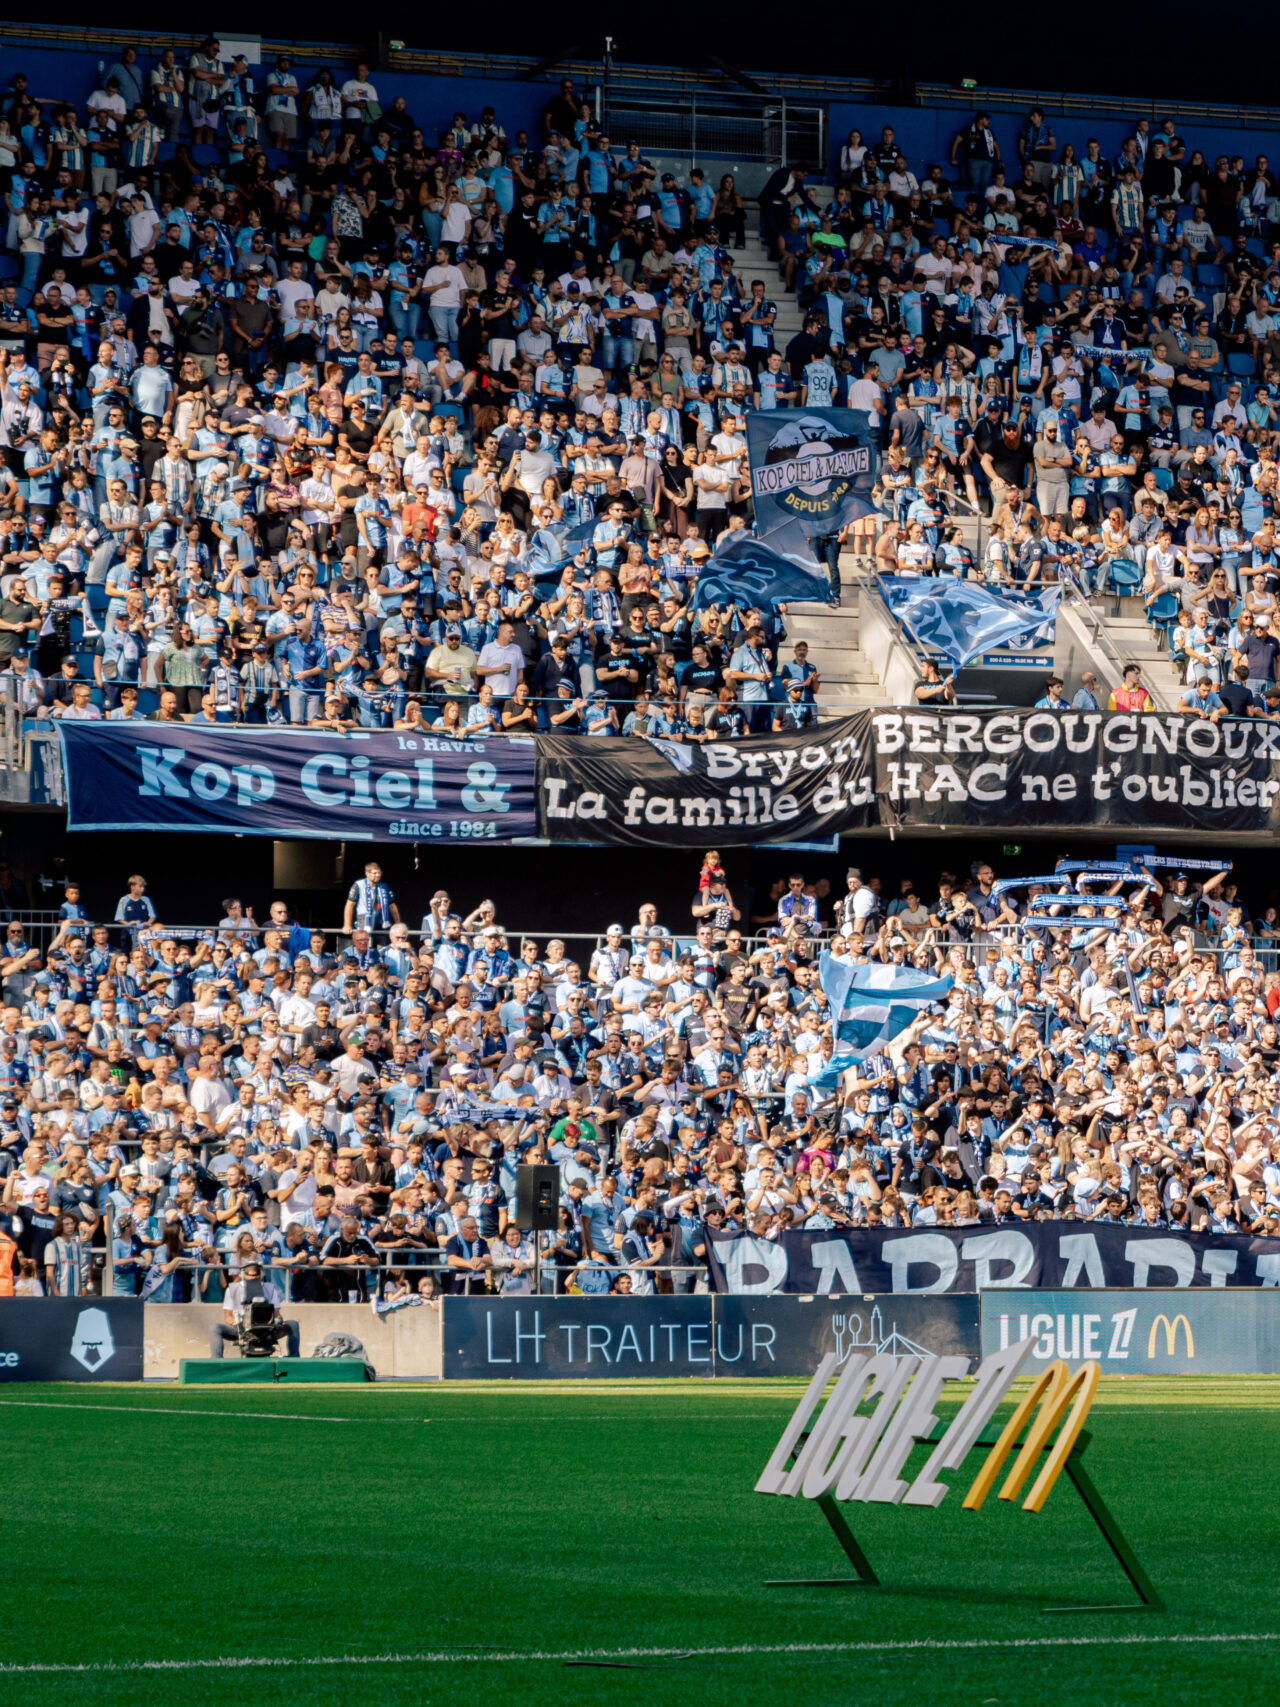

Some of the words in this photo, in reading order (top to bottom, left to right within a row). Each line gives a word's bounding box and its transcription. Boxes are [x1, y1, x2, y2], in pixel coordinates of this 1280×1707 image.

[812, 375, 828, 391] 93
[757, 466, 783, 492] KOP
[786, 458, 815, 485] CIEL
[816, 458, 824, 478] &
[825, 450, 867, 478] MARINE
[784, 492, 830, 513] DEPUIS
[397, 736, 418, 752] le
[422, 737, 485, 754] Havre
[701, 736, 861, 786] Bryan
[136, 746, 276, 808] Kop
[300, 753, 437, 810] Ciel
[460, 761, 511, 813] &
[544, 777, 608, 820] La
[623, 786, 800, 826] famille
[813, 772, 876, 814] du
[887, 761, 1007, 802] HAC
[1021, 773, 1079, 801] ne
[388, 819, 443, 837] since
[449, 820, 497, 838] 1984
[486, 1310, 547, 1363] LH
[559, 1323, 777, 1363] TRAITEUR
[1000, 1314, 1102, 1359] LIGUE
[753, 1352, 972, 1505] LIGUE
